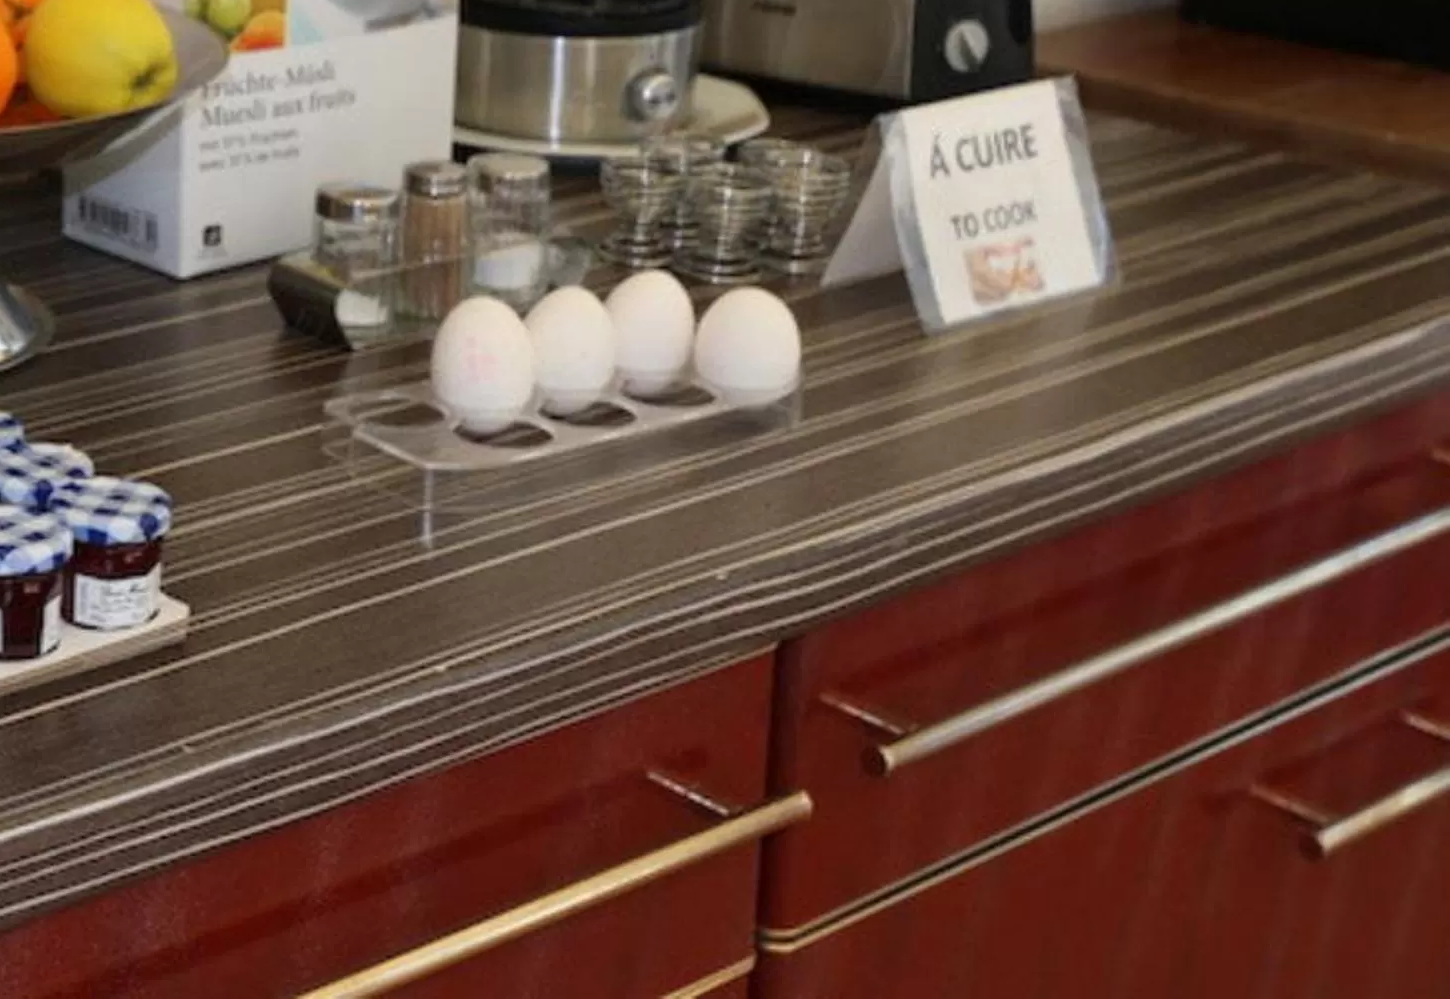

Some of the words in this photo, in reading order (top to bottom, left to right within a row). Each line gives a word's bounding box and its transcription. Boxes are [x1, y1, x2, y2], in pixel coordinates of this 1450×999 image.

[955, 122, 1038, 173] CUIRE
[951, 212, 979, 240] TO
[982, 199, 1038, 233] COOK
